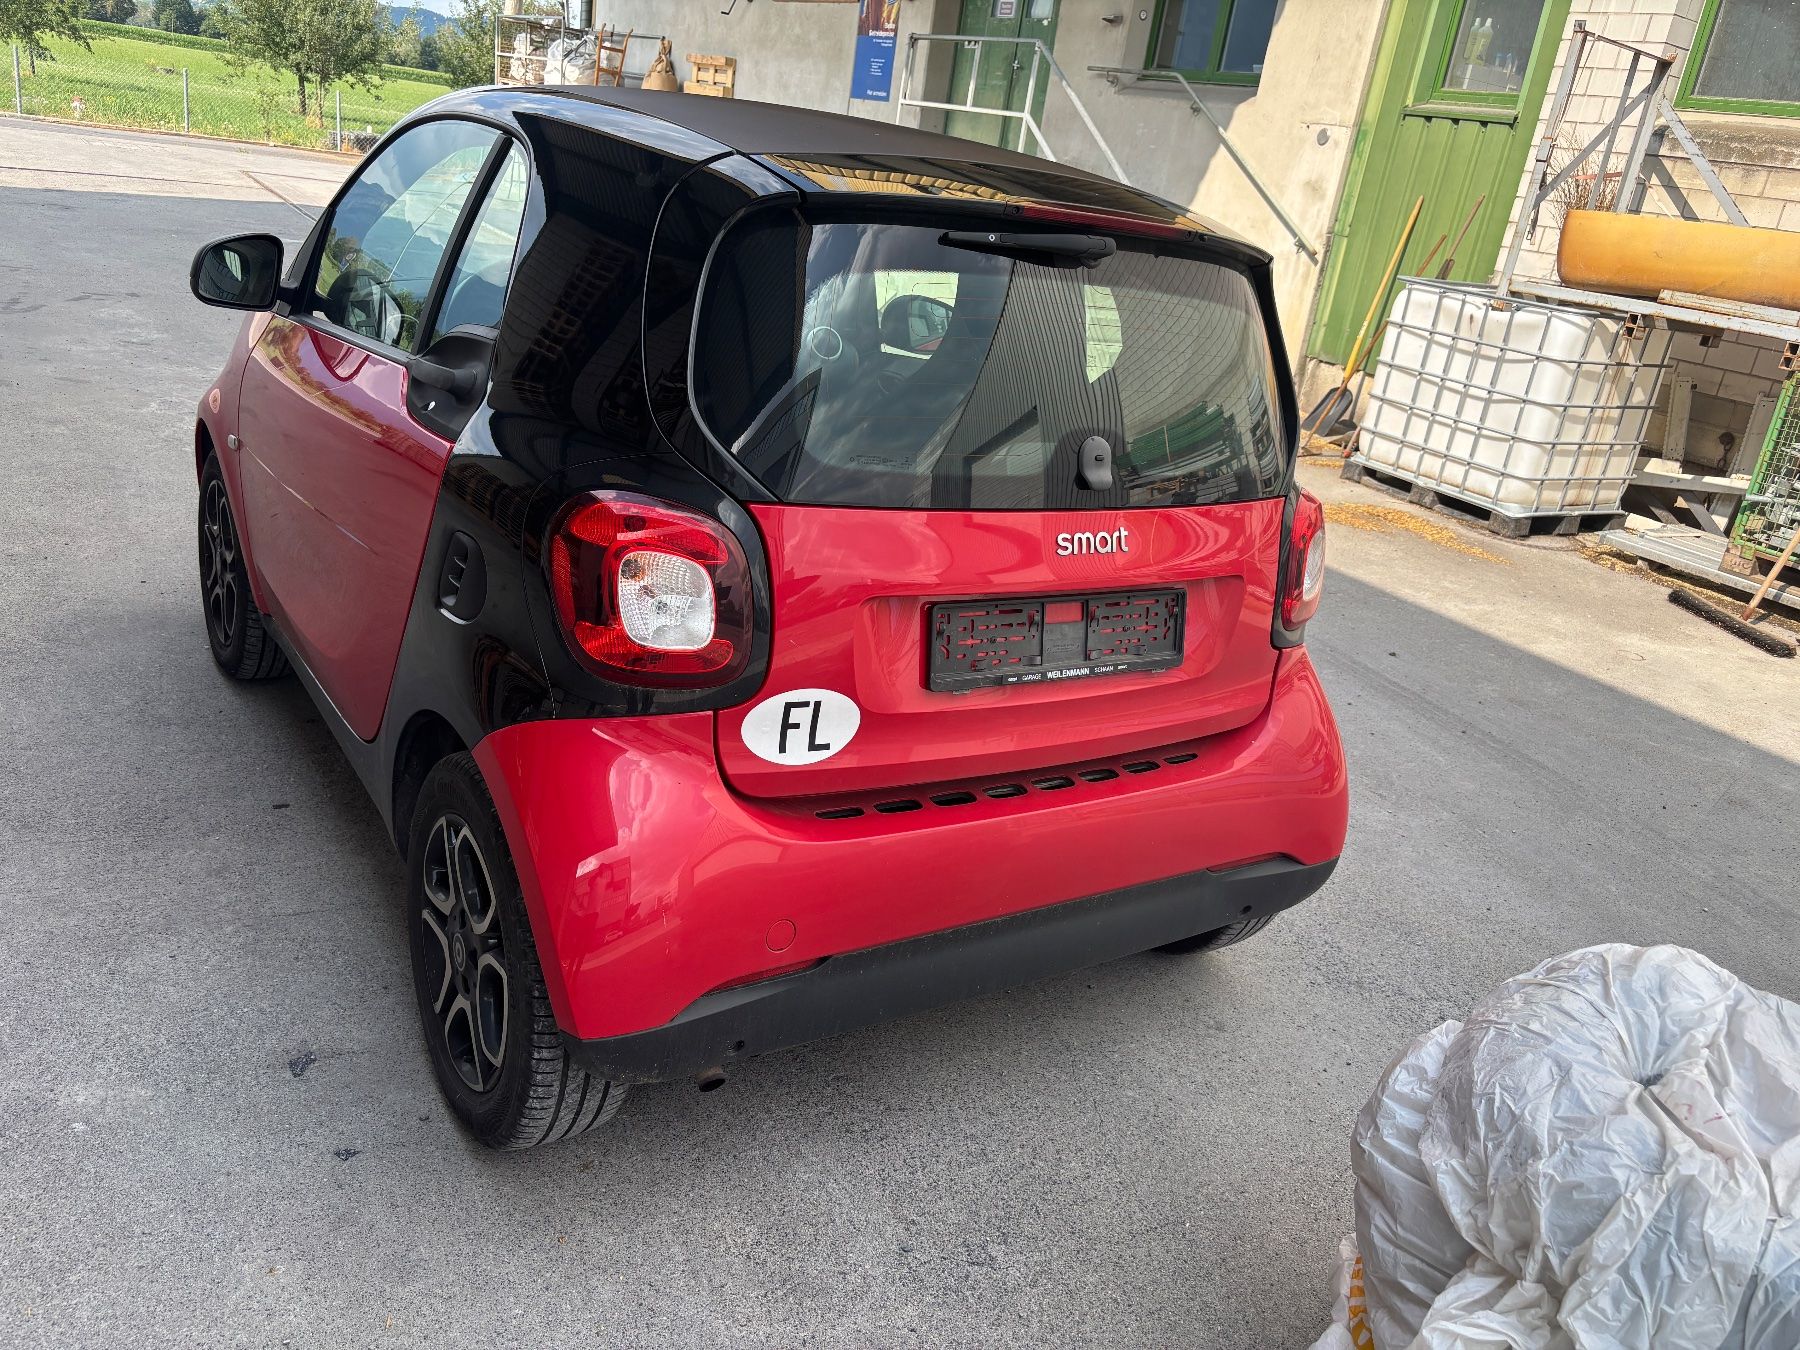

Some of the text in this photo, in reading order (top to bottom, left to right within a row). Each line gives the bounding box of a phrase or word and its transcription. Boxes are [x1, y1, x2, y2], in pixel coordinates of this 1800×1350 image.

[1056, 527, 1129, 556] smart
[1047, 668, 1089, 679] WEILENMANN
[779, 700, 831, 754] FL
